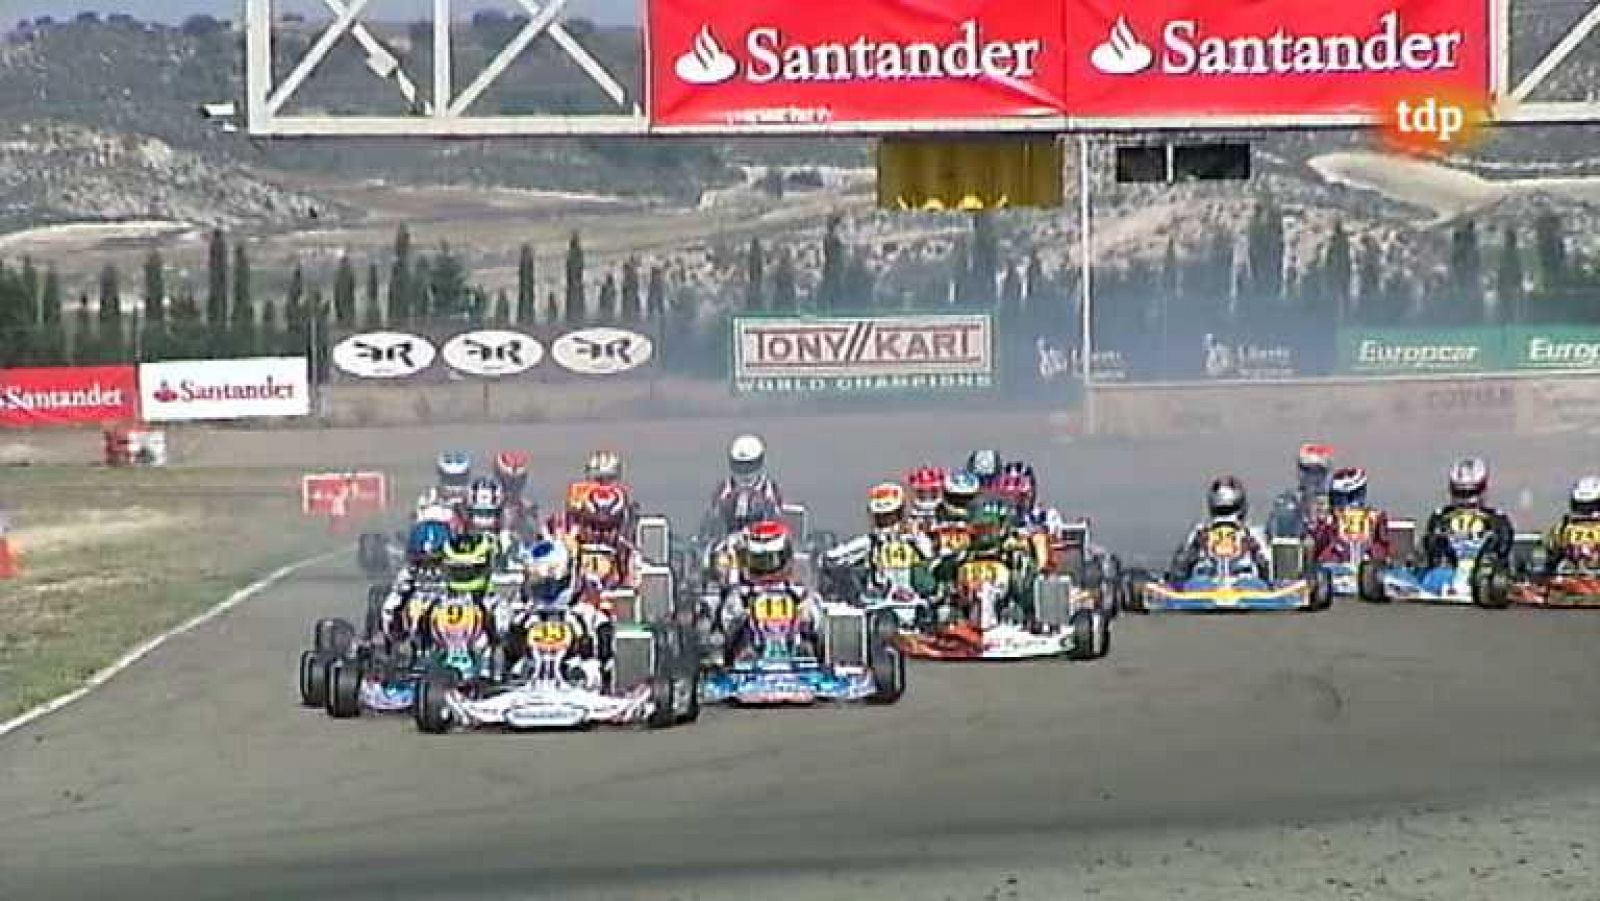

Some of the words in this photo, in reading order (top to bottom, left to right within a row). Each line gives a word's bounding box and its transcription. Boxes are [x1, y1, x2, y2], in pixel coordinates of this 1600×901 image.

[746, 19, 1038, 82] Santander
[1163, 12, 1461, 74] Santander
[1359, 339, 1480, 367] Europcar
[5, 383, 122, 410] Santander
[180, 376, 295, 401] Santander
